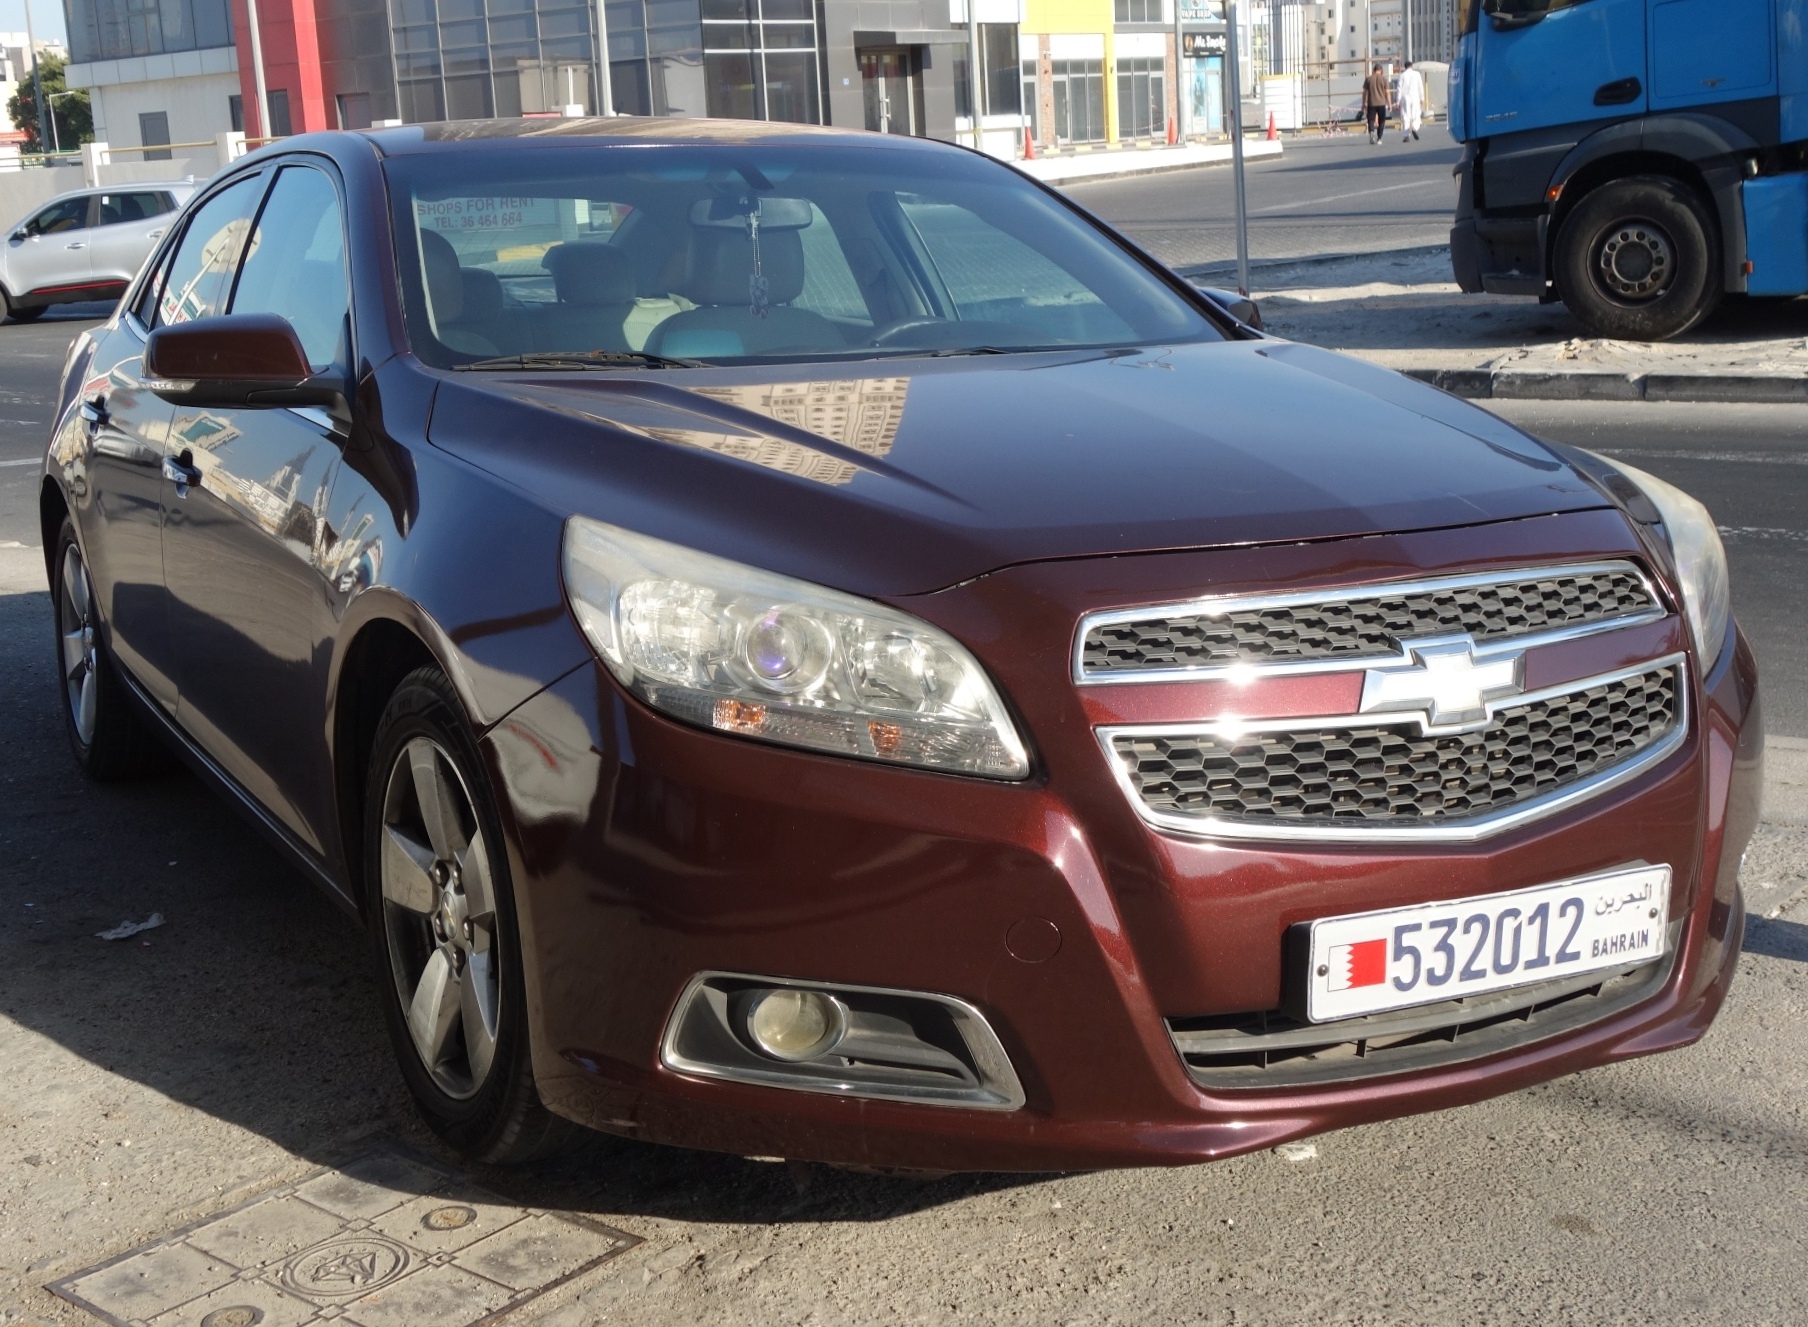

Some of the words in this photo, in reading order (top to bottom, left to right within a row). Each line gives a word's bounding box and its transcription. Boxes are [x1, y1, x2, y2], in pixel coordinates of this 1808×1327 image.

[1181, 9, 1196, 18] VAPE
[417, 202, 462, 216] SHOPS
[466, 198, 495, 213] FOR
[500, 198, 535, 209] RENT
[434, 216, 458, 229] TEL:
[461, 215, 474, 228] 36
[478, 214, 498, 227] 464
[1594, 882, 1653, 917] البحرين
[1392, 897, 1585, 993] 532012
[1591, 928, 1650, 959] BAHRAIN
